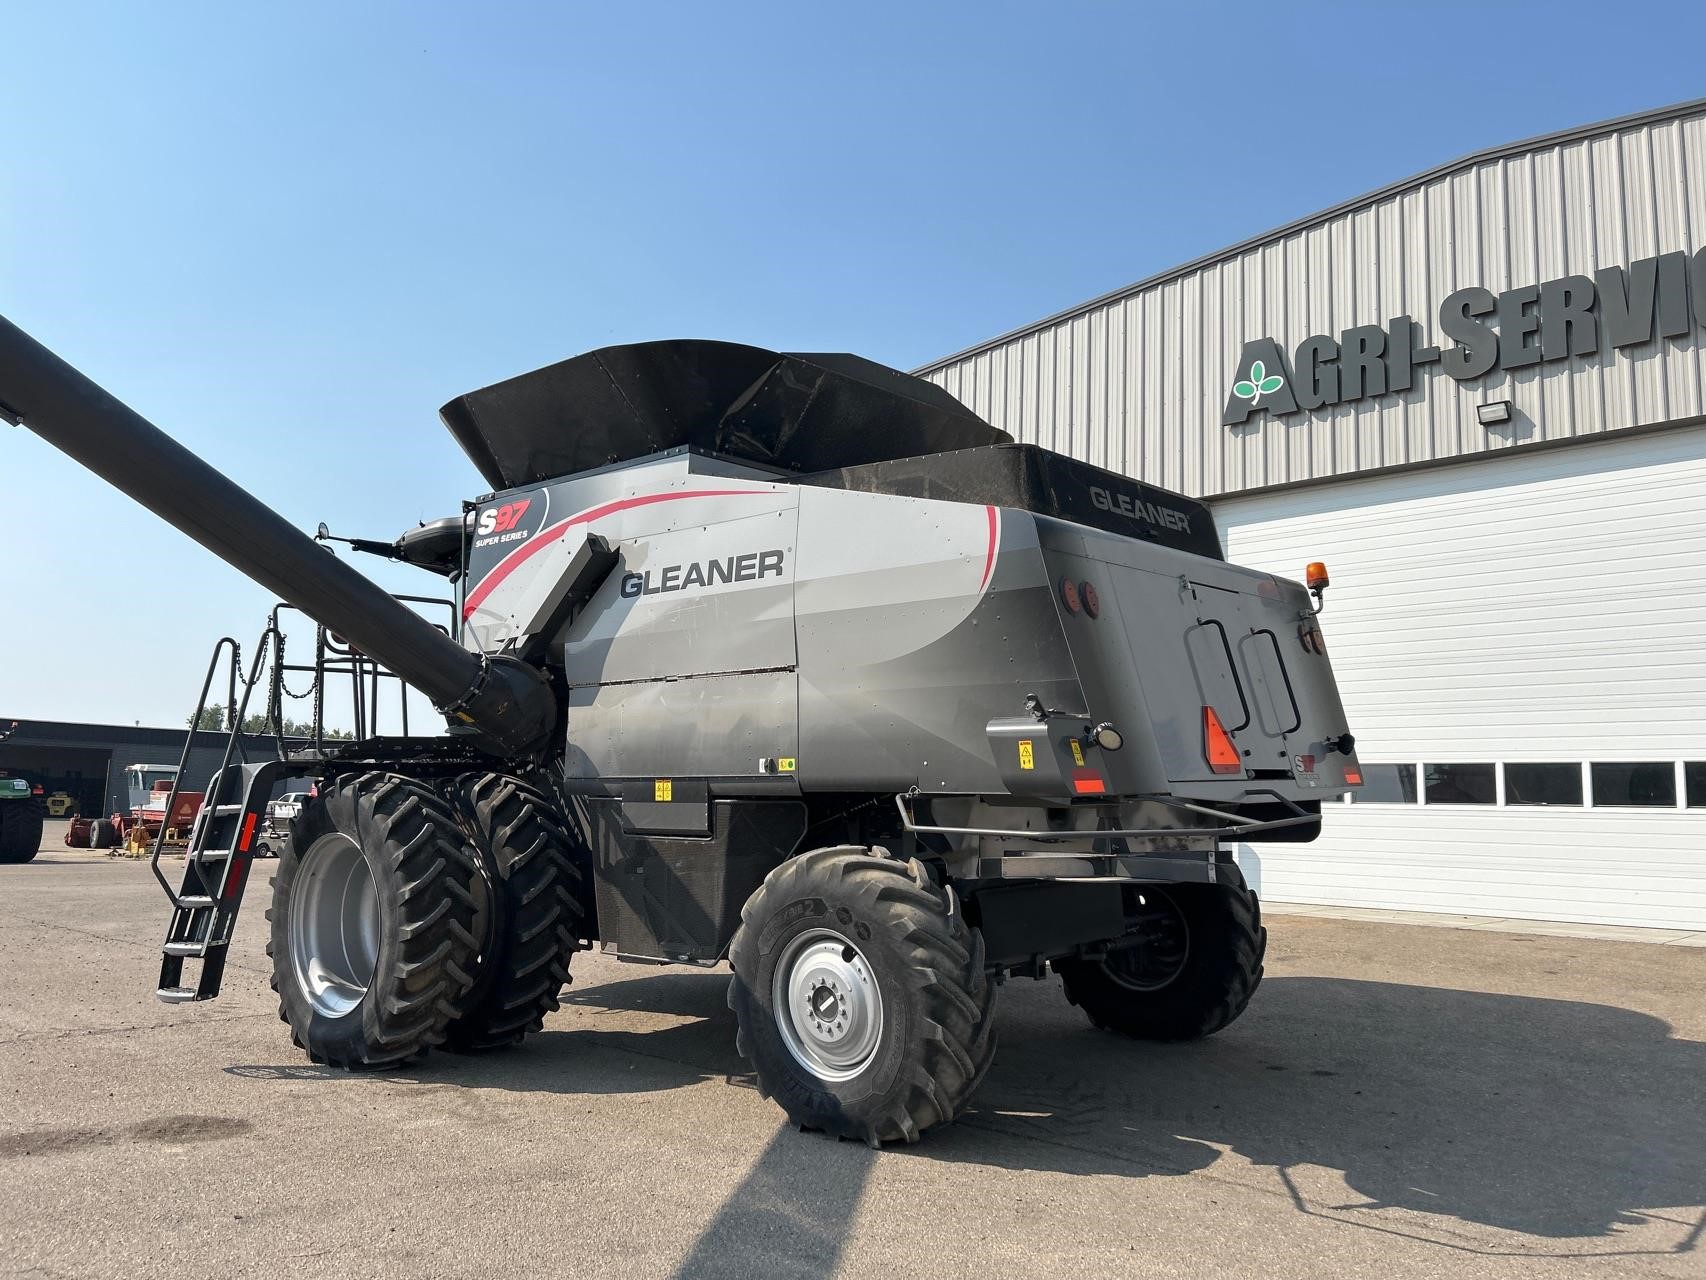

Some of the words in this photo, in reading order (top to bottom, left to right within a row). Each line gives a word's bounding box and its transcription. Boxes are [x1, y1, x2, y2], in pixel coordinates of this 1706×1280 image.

[1223, 246, 1706, 426] AGRI-SERVI
[477, 499, 532, 536] S97
[1089, 486, 1191, 535] GLEANER
[475, 536, 500, 548] SUPER
[500, 530, 528, 543] SERIES
[620, 549, 784, 599] GLEANER
